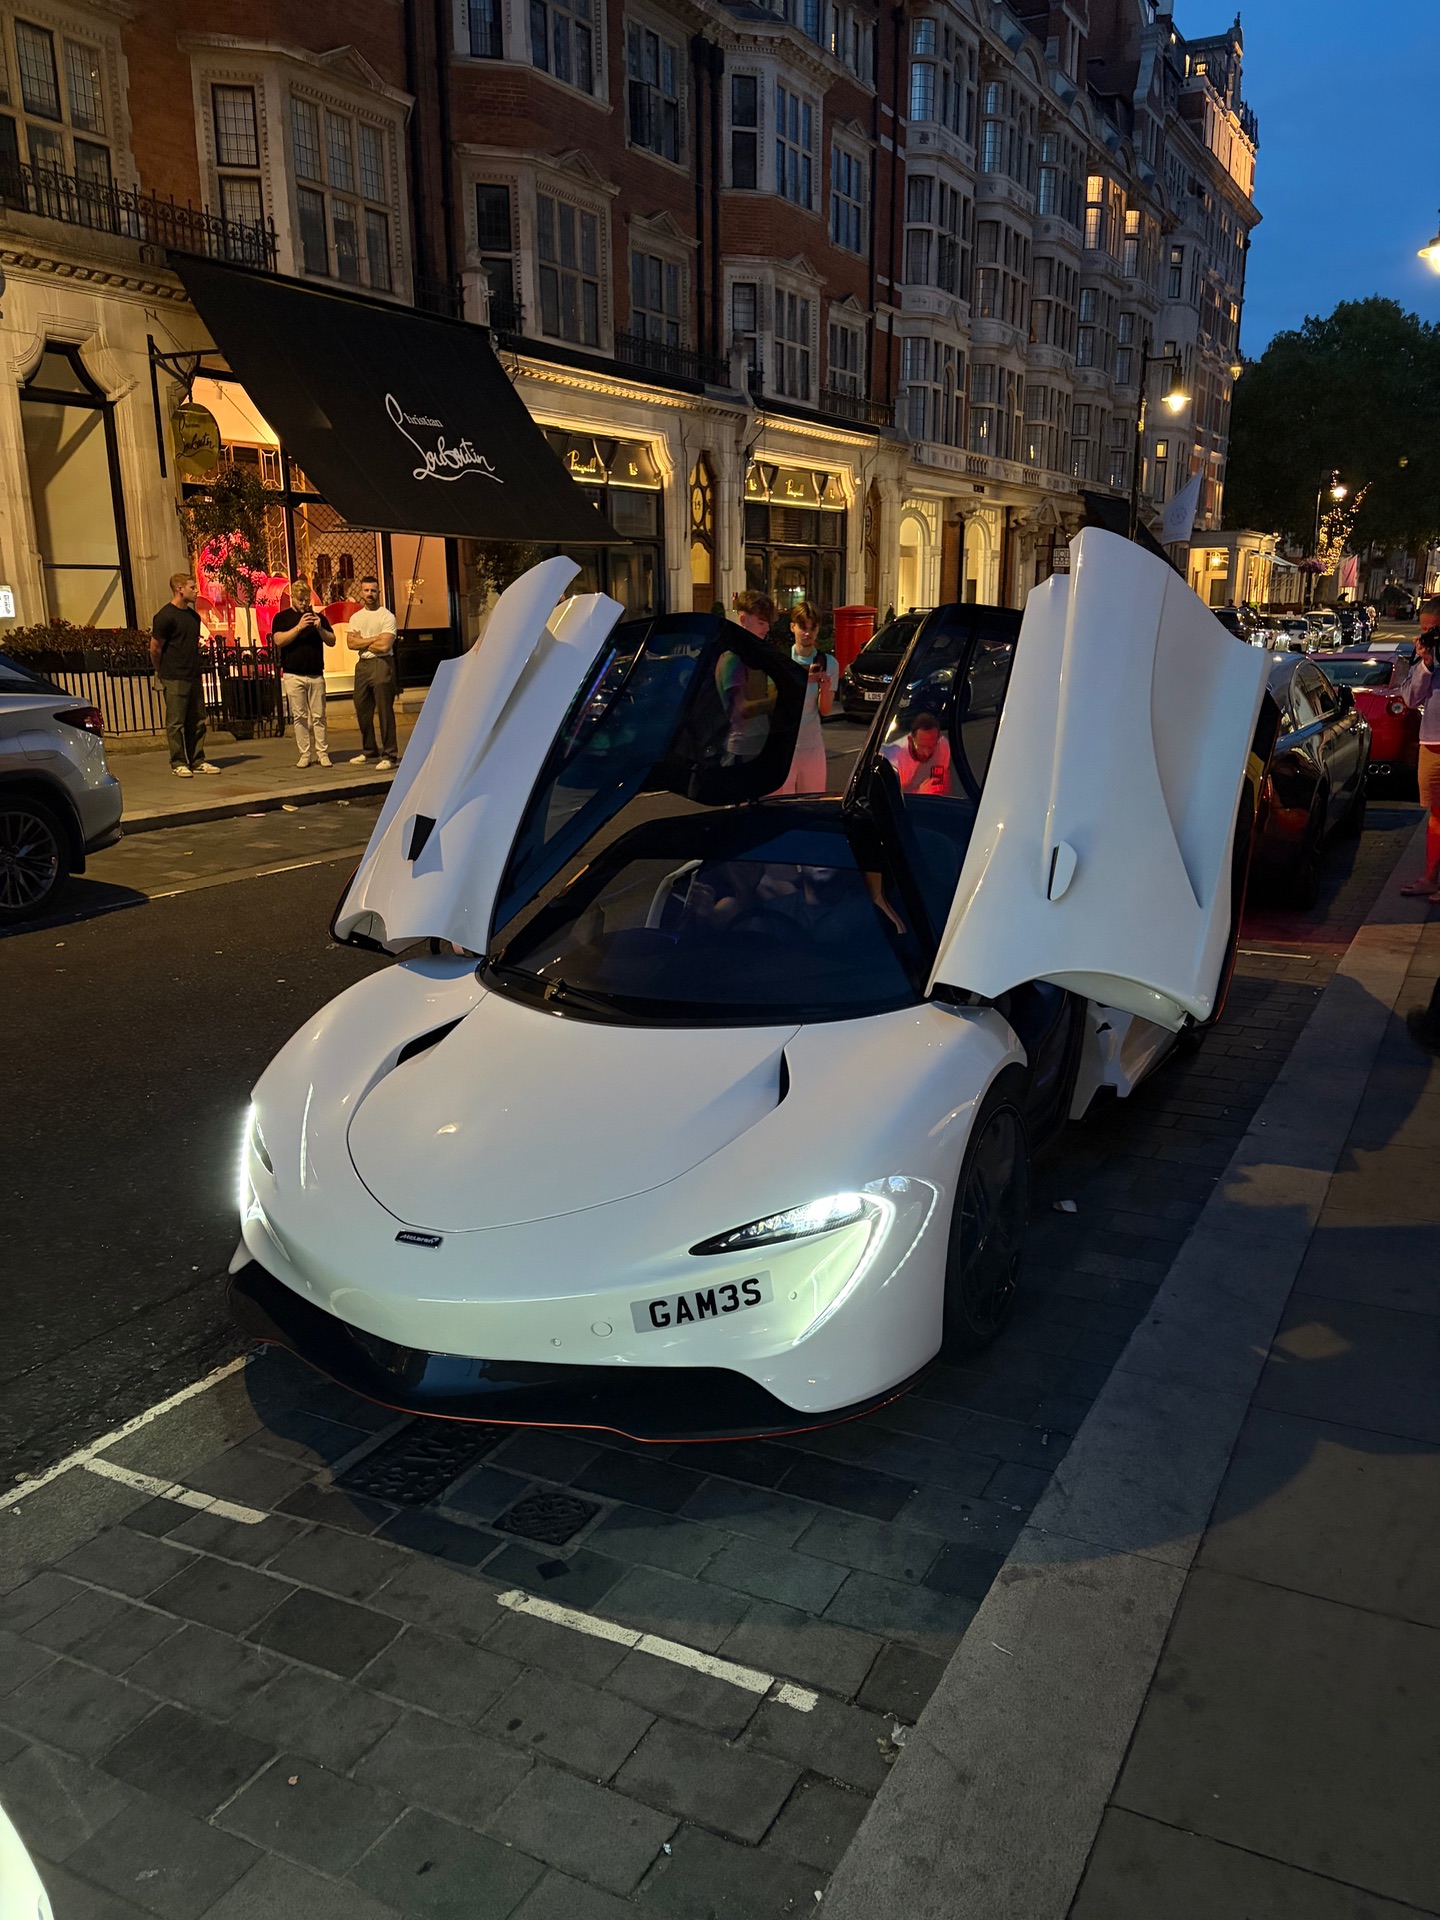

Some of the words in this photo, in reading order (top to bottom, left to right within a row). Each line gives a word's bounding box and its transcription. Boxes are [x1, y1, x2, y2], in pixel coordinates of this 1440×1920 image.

[385, 393, 444, 428] Christian
[412, 435, 504, 484] Louboutin
[648, 1277, 762, 1328] GAM3S
